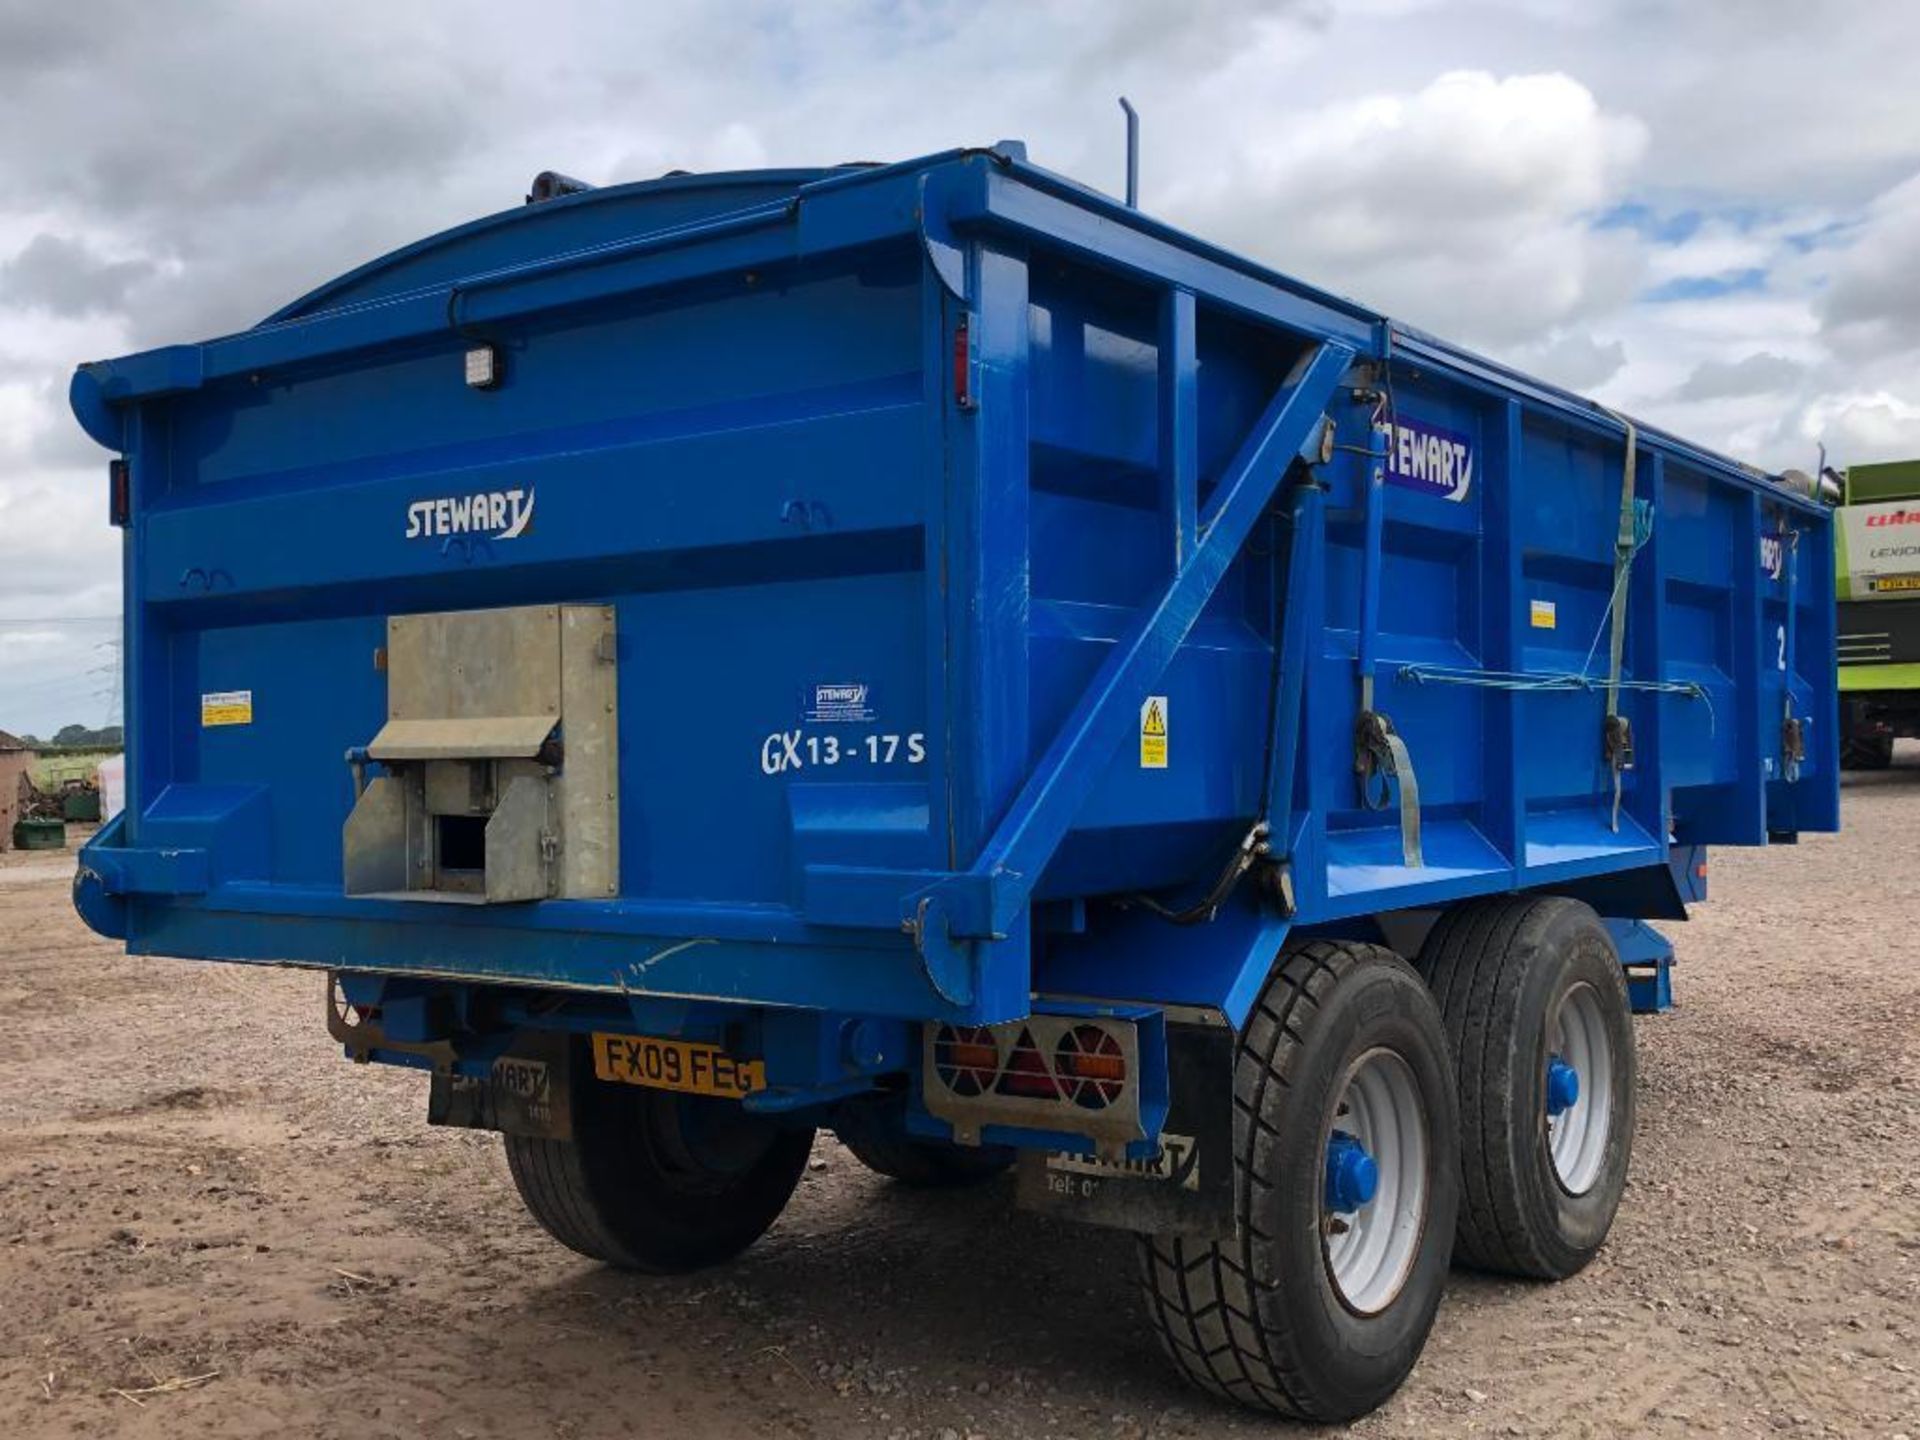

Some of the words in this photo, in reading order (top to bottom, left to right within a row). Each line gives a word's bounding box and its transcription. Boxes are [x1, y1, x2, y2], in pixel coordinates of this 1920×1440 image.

[1373, 421, 1472, 502] TEWART
[406, 487, 534, 540] STEWART
[606, 1039, 682, 1084] FX09
